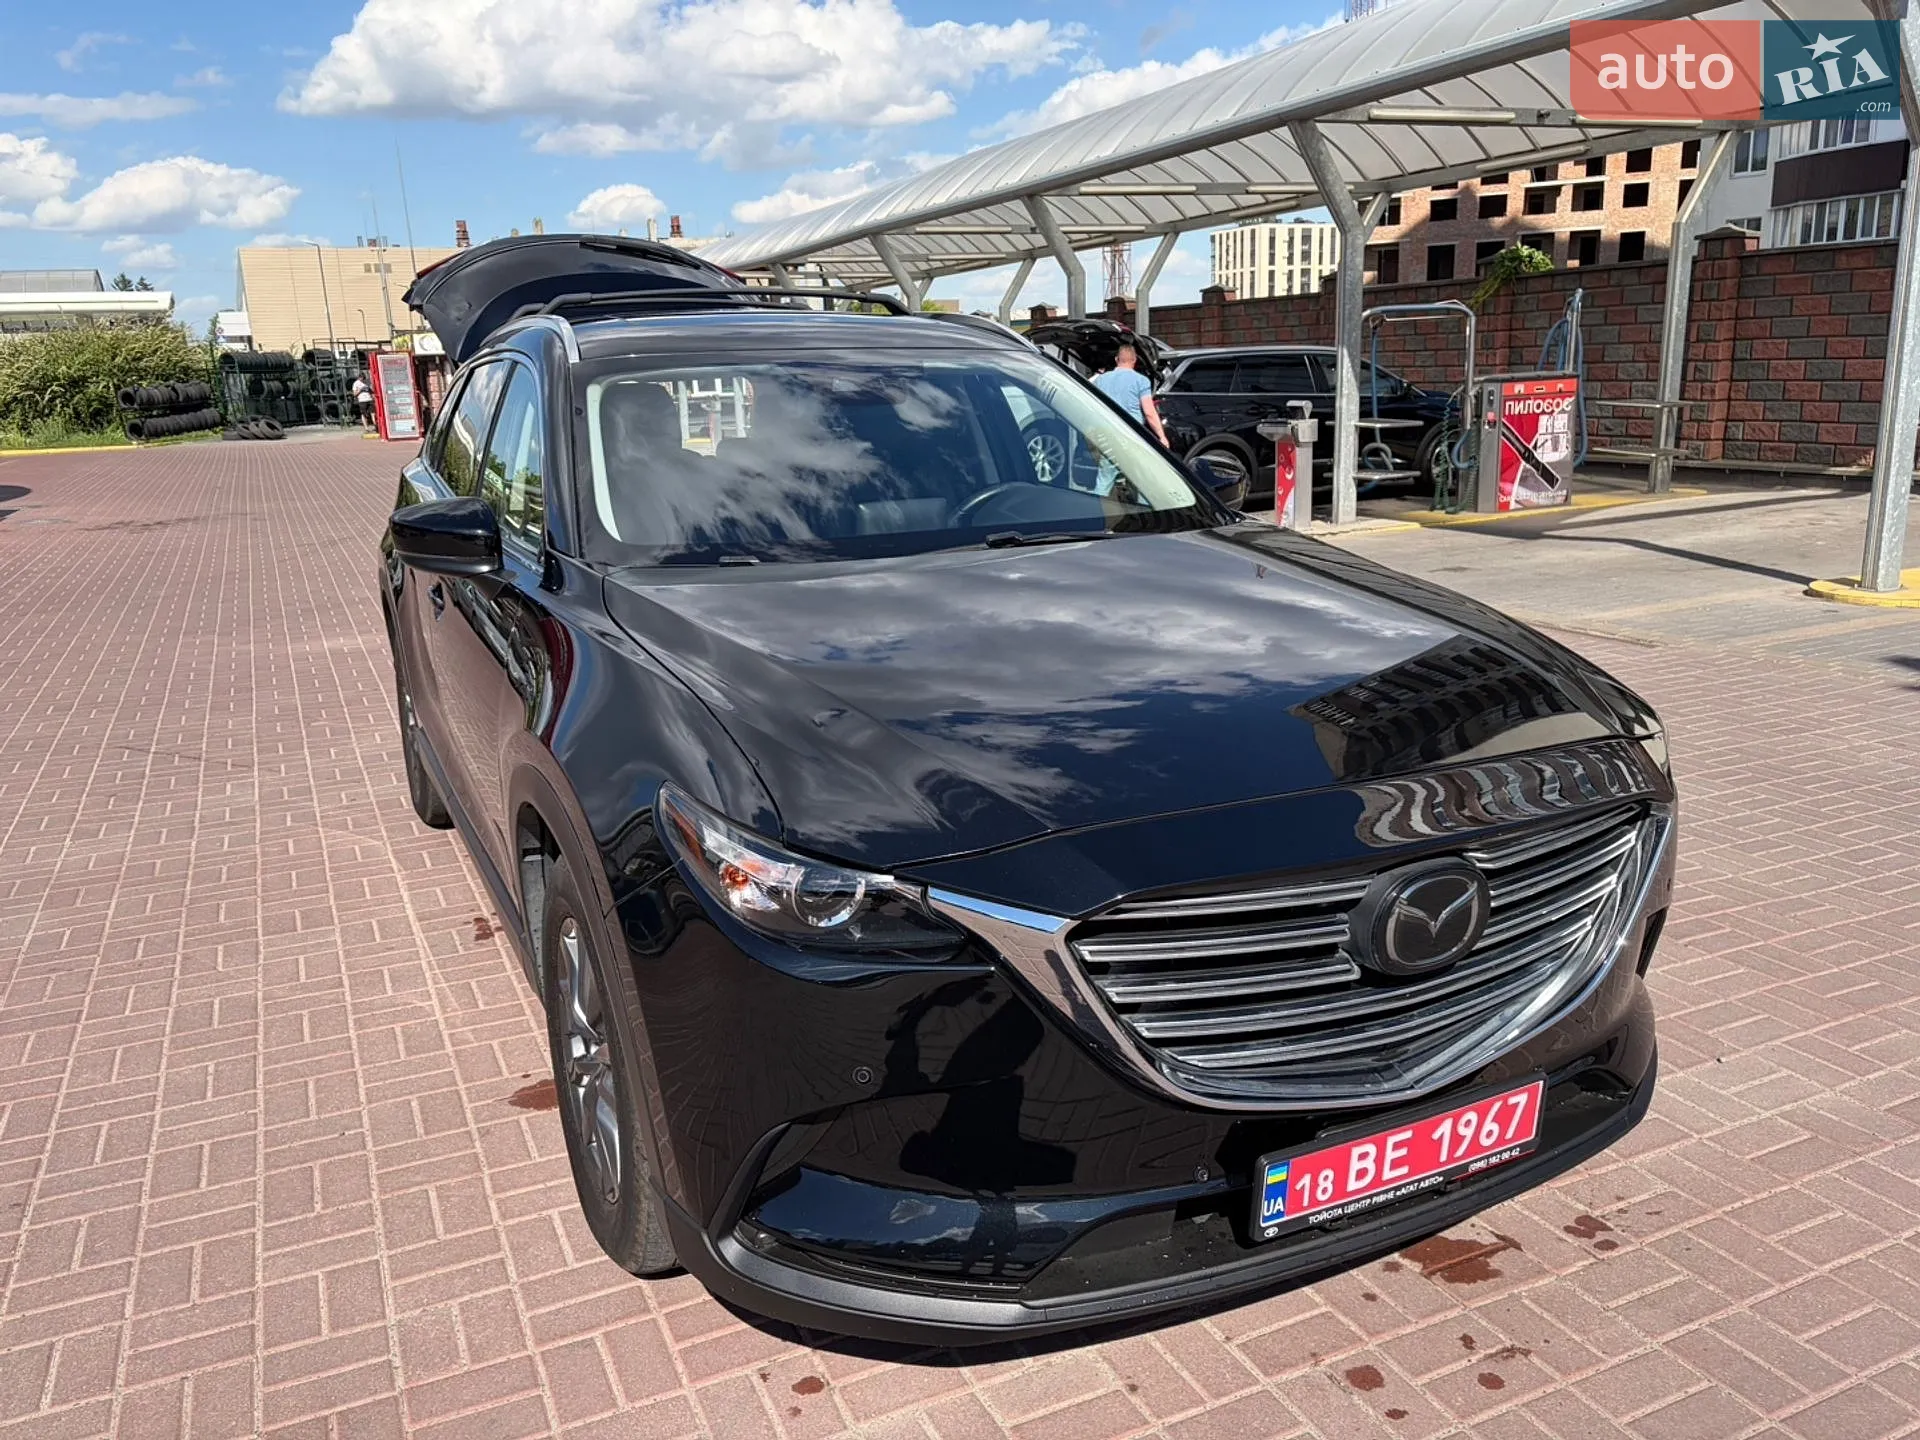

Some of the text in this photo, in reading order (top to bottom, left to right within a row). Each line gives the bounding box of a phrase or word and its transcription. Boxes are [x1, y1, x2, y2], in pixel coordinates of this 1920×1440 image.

[1295, 1168, 1334, 1207] 18
[1431, 1092, 1528, 1163] 1967
[1263, 1197, 1284, 1216] UA
[1308, 1207, 1343, 1225] ТОЙОТА
[1343, 1198, 1372, 1214] ЦЕНТР
